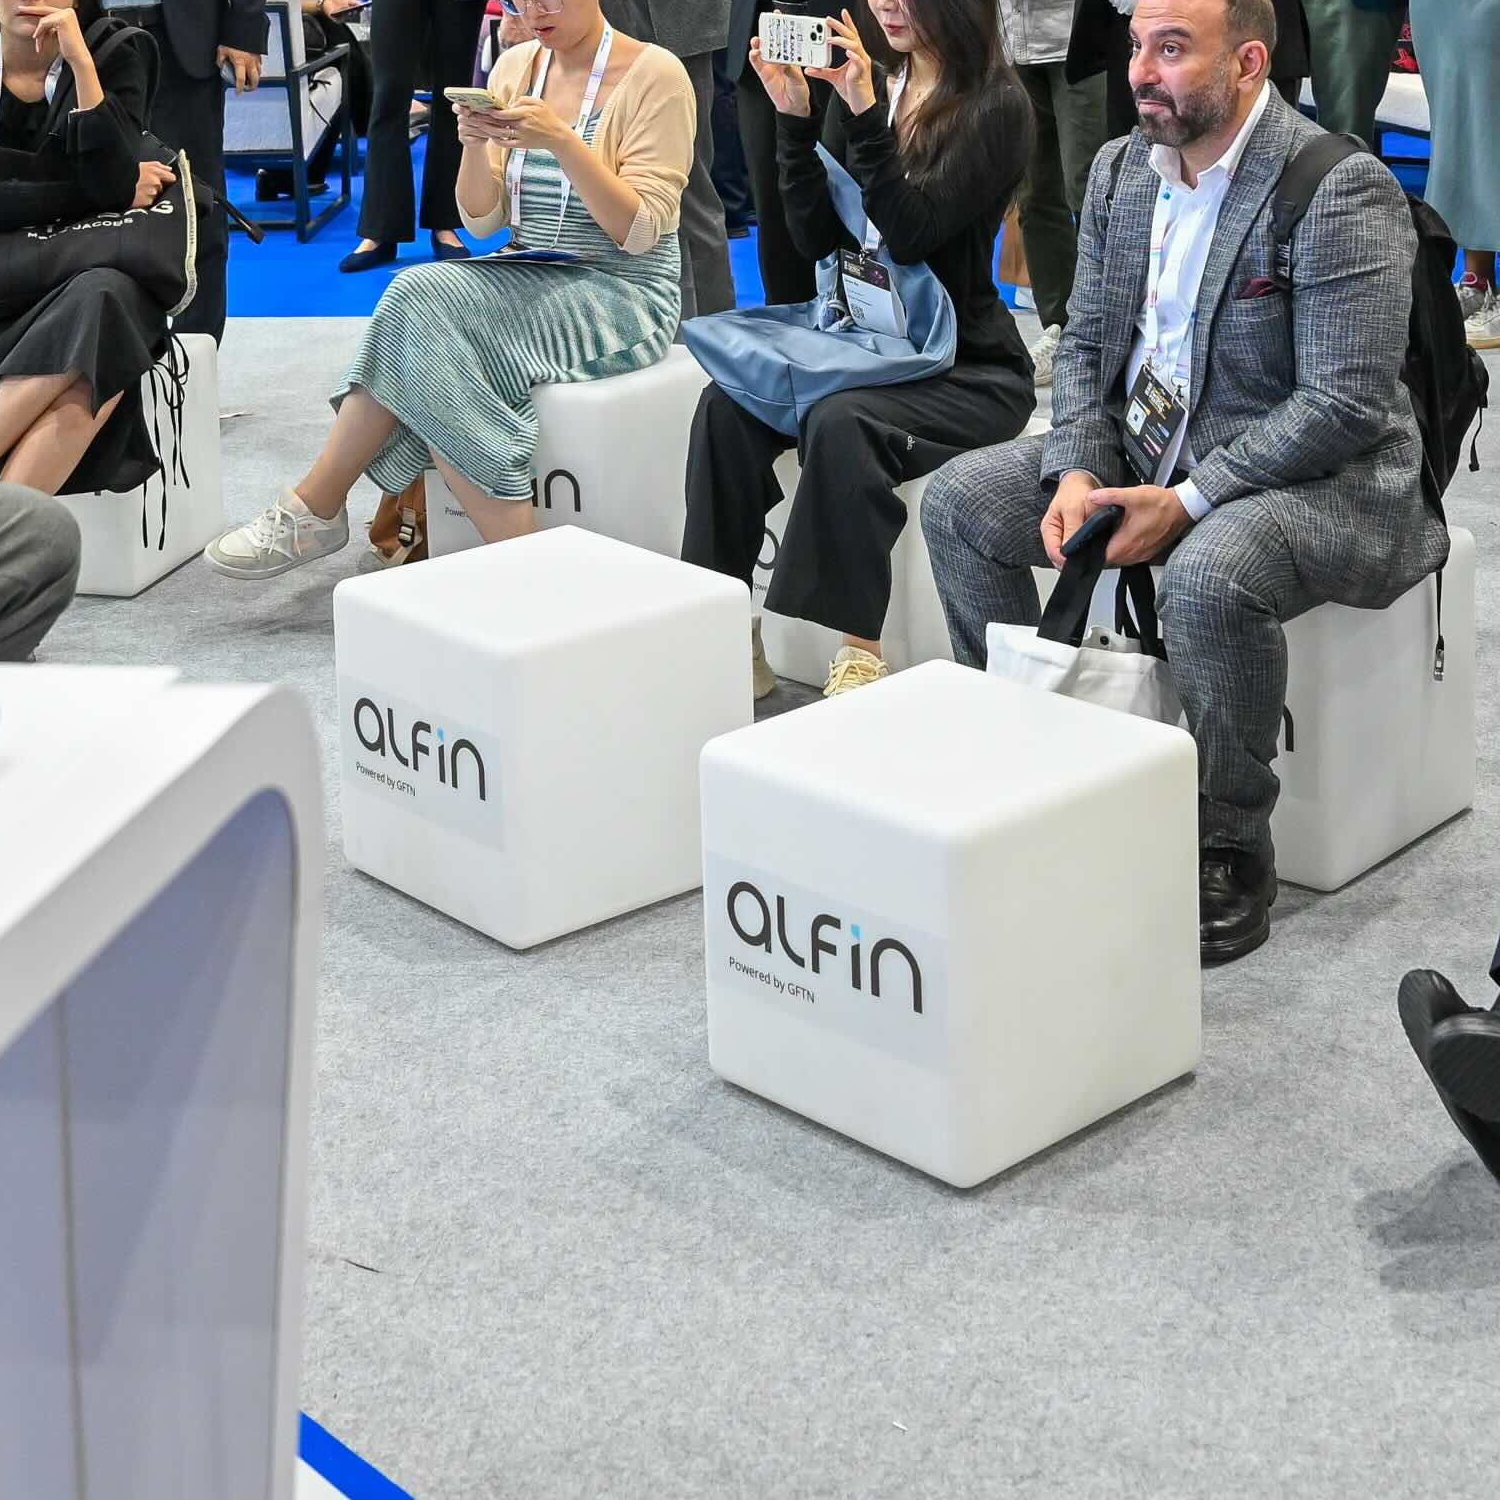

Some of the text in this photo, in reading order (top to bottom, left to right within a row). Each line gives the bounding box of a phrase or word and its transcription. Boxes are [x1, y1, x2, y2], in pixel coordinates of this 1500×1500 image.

[72, 217, 134, 230] JACOBS
[356, 761, 416, 797] Powered by GFTN
[729, 956, 815, 1004] Powered by GFTN
